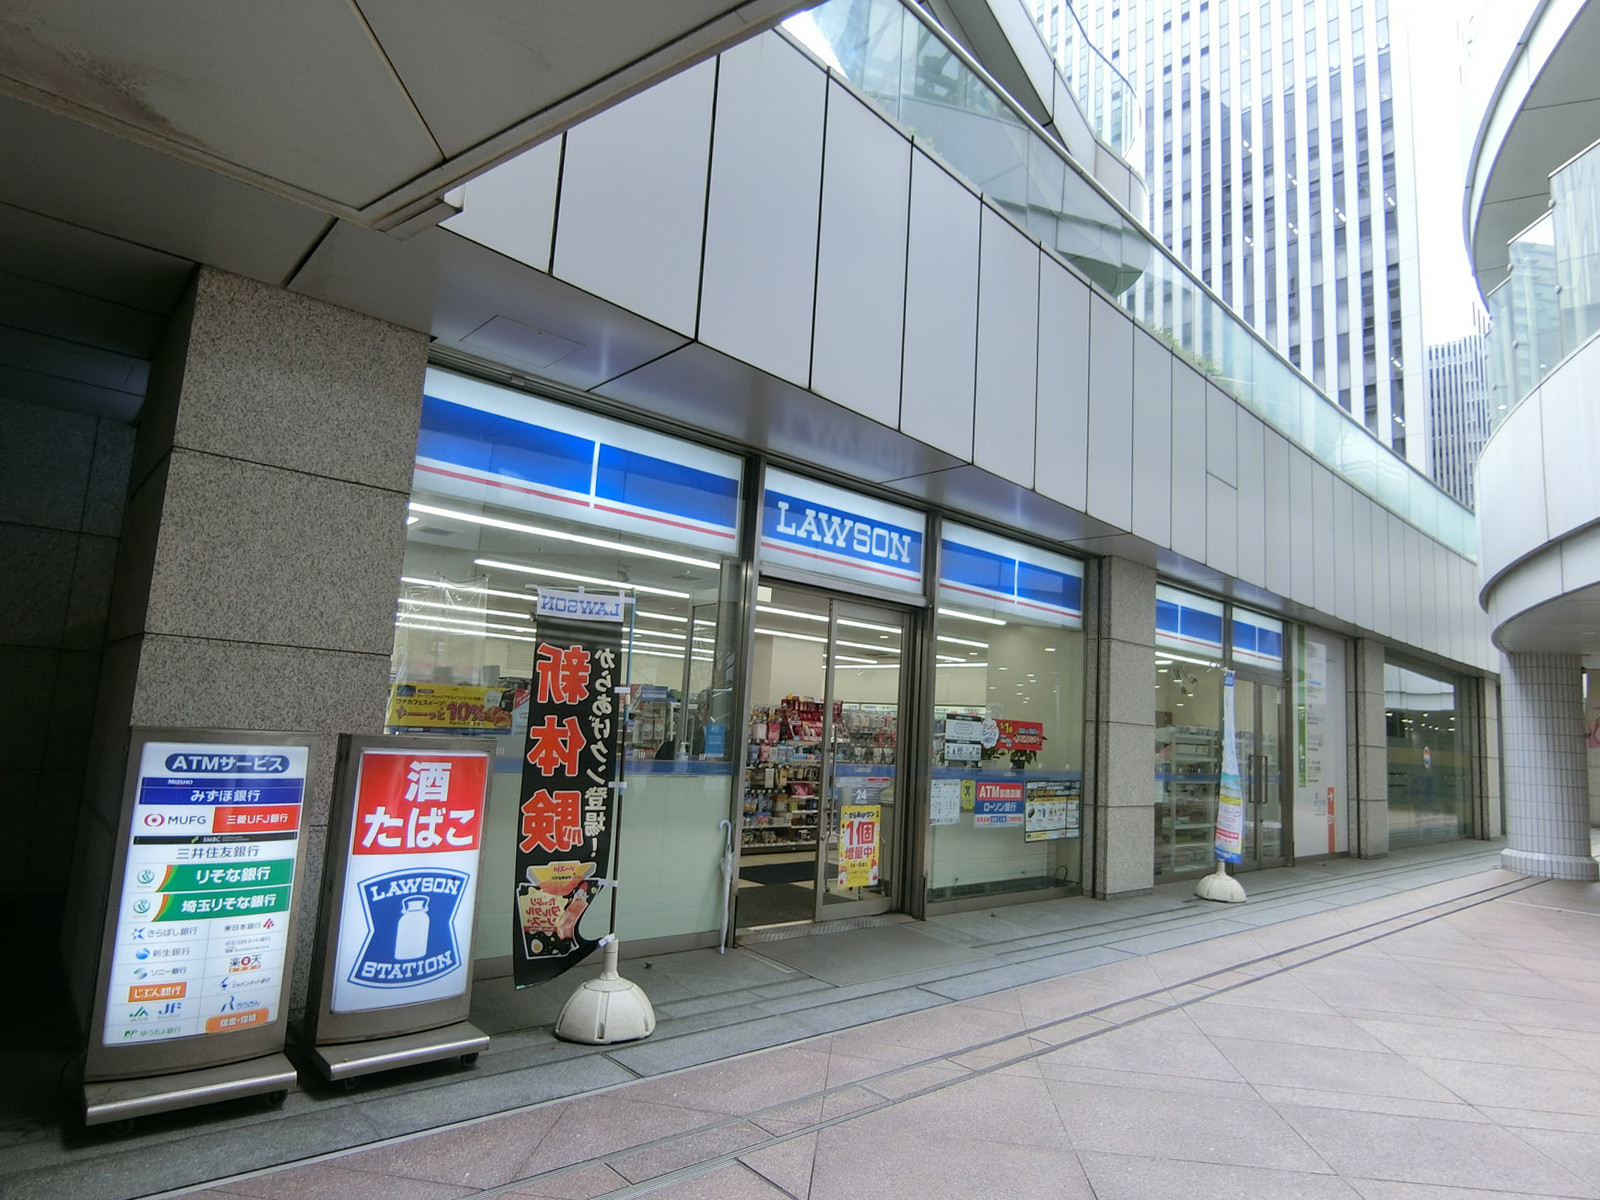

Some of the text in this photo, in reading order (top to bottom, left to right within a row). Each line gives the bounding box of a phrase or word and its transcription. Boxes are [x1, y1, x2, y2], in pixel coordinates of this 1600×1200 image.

[776, 501, 911, 563] LAWSON
[172, 755, 284, 772] ATMサービス
[405, 760, 452, 802] 酒
[190, 789, 261, 802] みずほ銀行
[168, 815, 207, 825] MUFG
[226, 813, 289, 825] 三菱UFJ銀行
[362, 806, 475, 849] たばこ
[846, 821, 876, 845] 1個
[176, 845, 260, 860] 三井住友銀行
[196, 866, 271, 884] りそな銀行
[370, 877, 461, 902] LAWSON
[181, 893, 277, 913] 埼玉りそな銀行
[148, 927, 198, 938] きらぼし銀行
[153, 947, 190, 957] 新生銀行
[151, 967, 187, 976] ソニー銀行
[361, 950, 452, 979] STATION
[133, 986, 181, 998] じぶん銀行
[140, 1026, 181, 1036] ゆうちょ銀行
